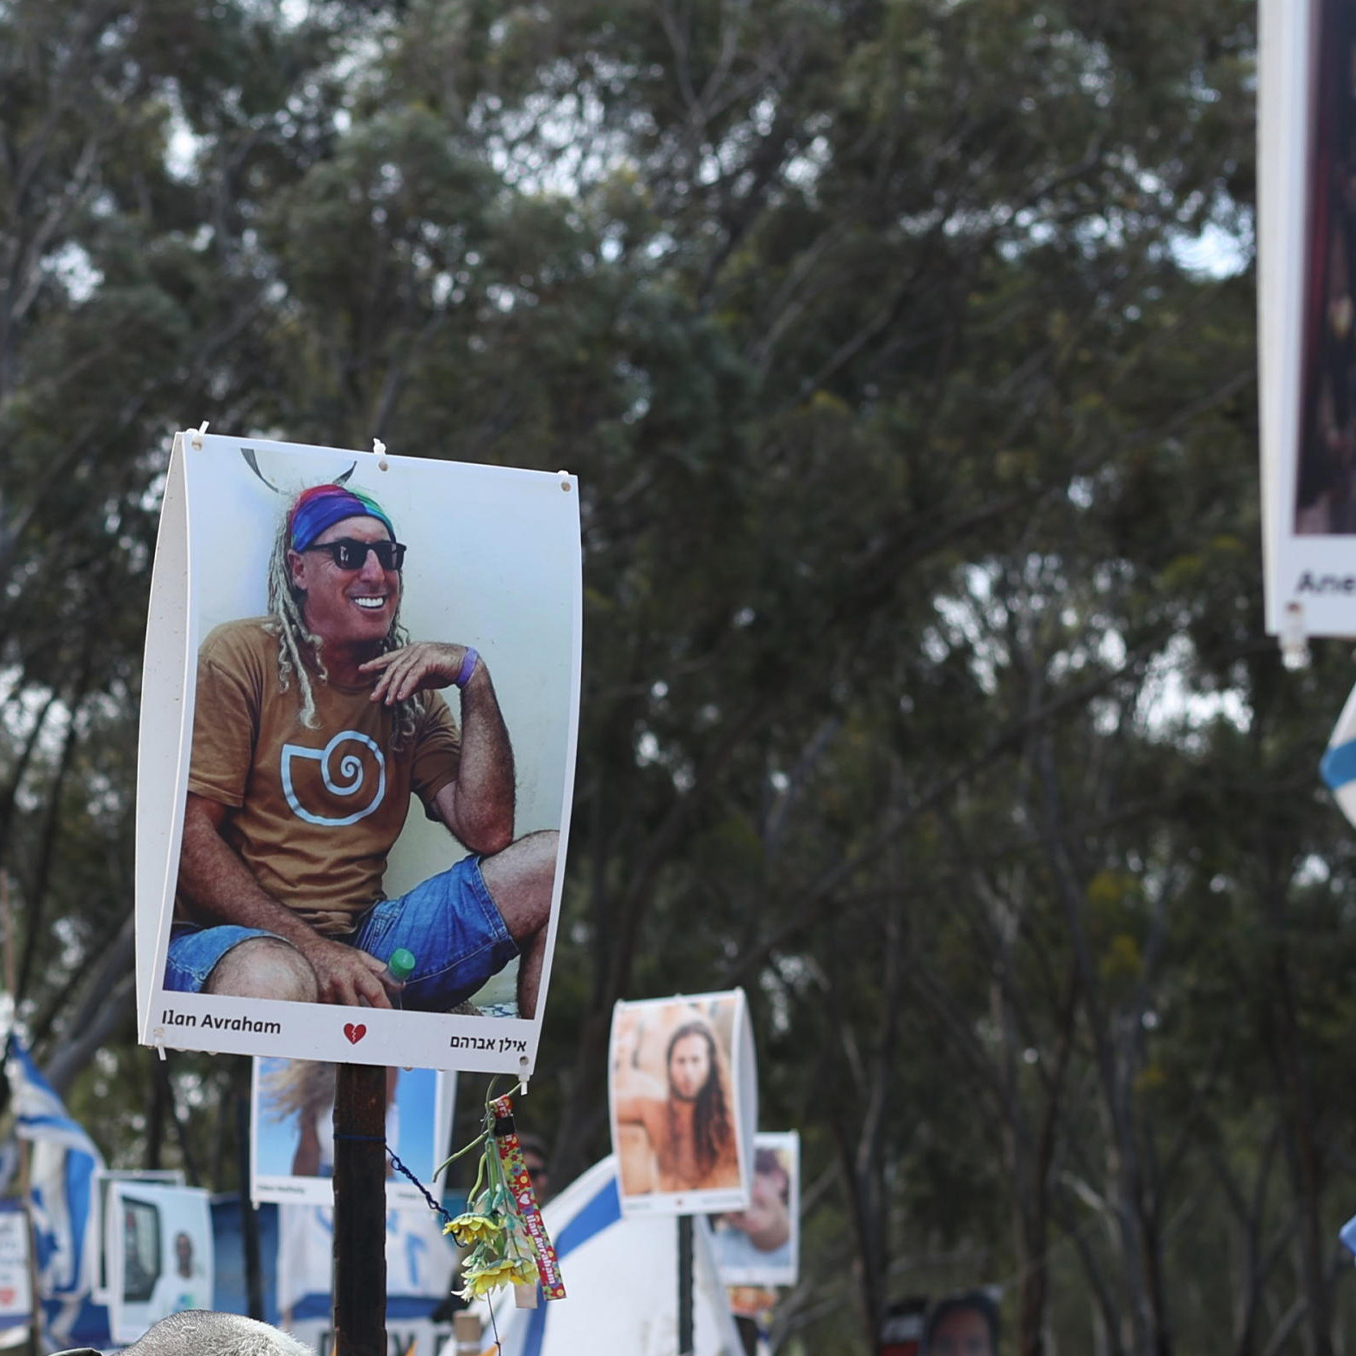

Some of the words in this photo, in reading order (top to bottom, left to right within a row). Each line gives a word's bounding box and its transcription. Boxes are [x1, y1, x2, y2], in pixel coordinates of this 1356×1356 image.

[161, 1009, 197, 1028] Ilan
[201, 1013, 281, 1034] Avraham
[449, 1035, 496, 1051] אברהם
[499, 1038, 527, 1053] אילן
[526, 1214, 538, 1237] Ilan
[535, 1236, 557, 1285] Avraham
